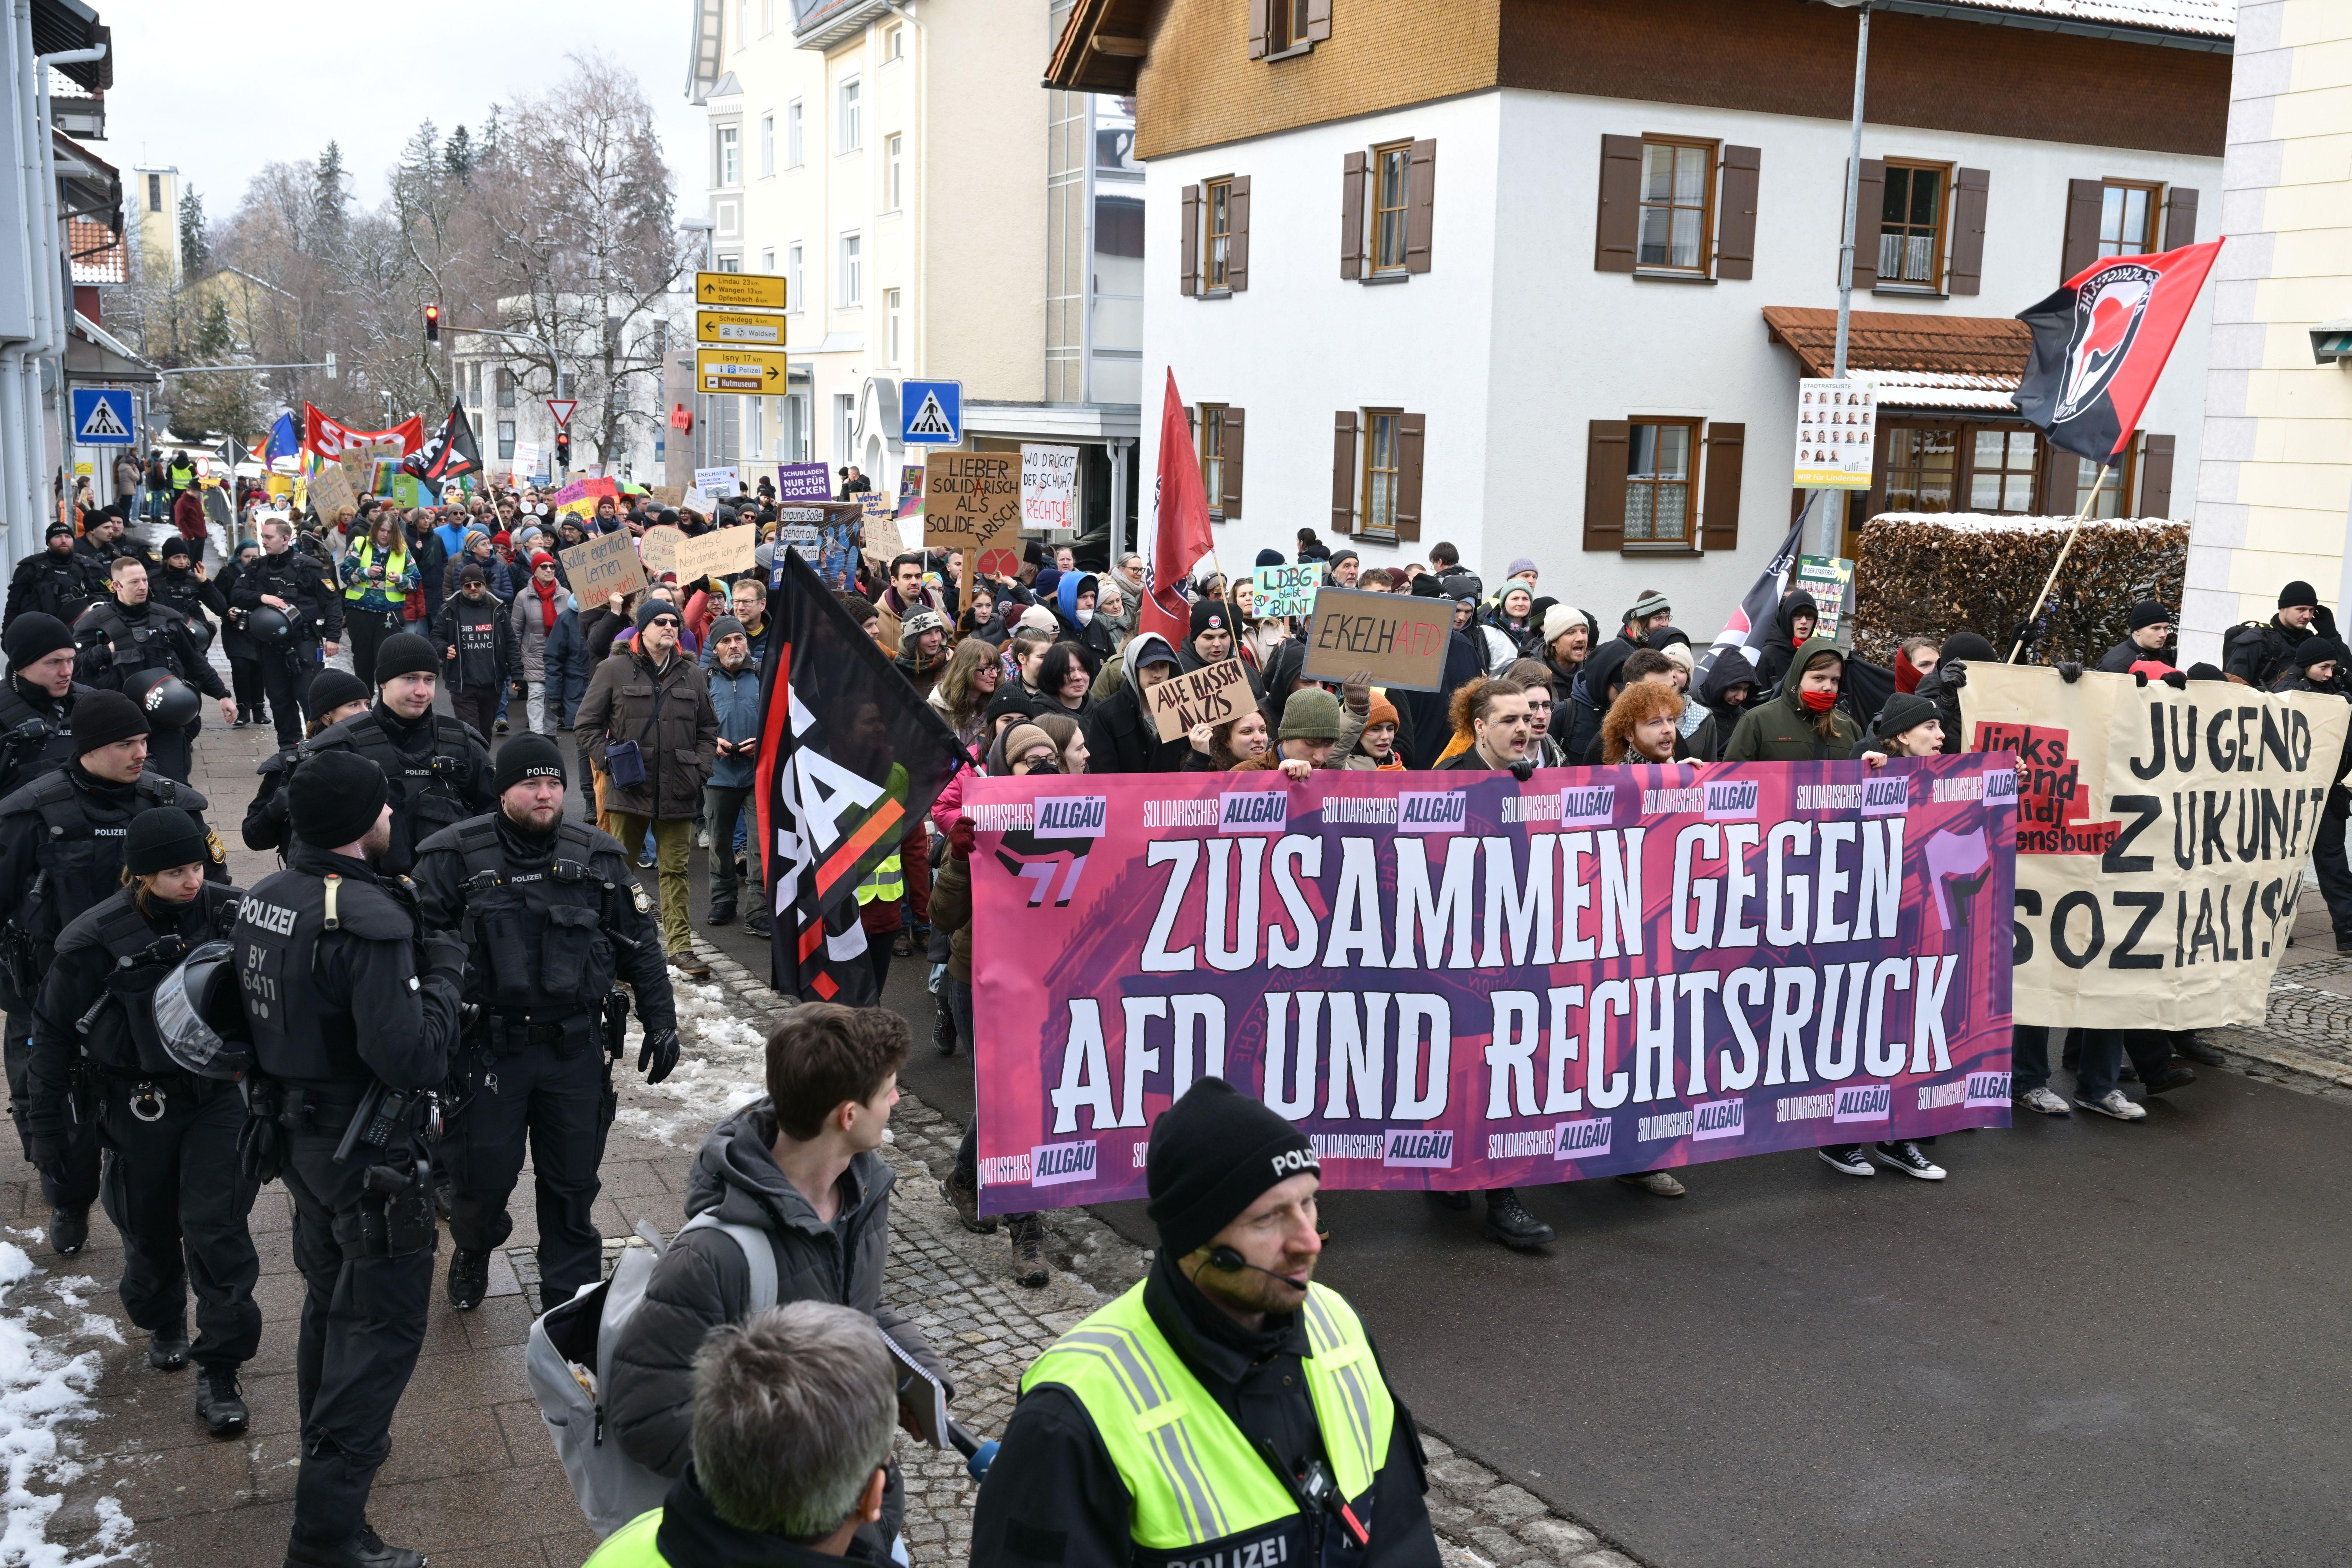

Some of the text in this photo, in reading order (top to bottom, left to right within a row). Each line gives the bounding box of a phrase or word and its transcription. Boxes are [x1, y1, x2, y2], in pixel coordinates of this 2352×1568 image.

[719, 316, 752, 324] Scheidegg
[723, 354, 739, 363] Isny
[722, 379, 757, 388] Hutmuseum
[950, 457, 1008, 480] LIEBER
[1024, 452, 1075, 469] WO DRÜCKT
[1844, 462, 1859, 472] ulli
[394, 476, 411, 485] EINE
[783, 469, 824, 477] SCHUBLADEN
[784, 475, 825, 487] NUR FÜR
[1024, 473, 1071, 493] DER SCHUH?
[1826, 475, 1868, 483] Lindenberg
[786, 486, 826, 496] SOCKEN
[932, 478, 1018, 498] SOLIDARISCH
[783, 509, 822, 521] braune Soße
[864, 508, 890, 518] fängen
[956, 495, 989, 513] ALS
[1026, 499, 1067, 527] RECHTS!
[784, 527, 817, 540] gehört auf
[865, 515, 880, 529] DAS
[883, 521, 887, 531] B
[867, 529, 879, 539] AFD
[926, 514, 975, 534] SOLIDE
[975, 500, 1019, 546] ARISCH
[653, 529, 679, 543] HALLO
[562, 533, 630, 570] Sollte eigentlich
[679, 556, 695, 568] Nein
[722, 547, 732, 557] ich
[735, 543, 748, 558] geh
[802, 547, 817, 558] nicht
[614, 573, 639, 594] auch!
[1264, 567, 1312, 590] LDBG
[1279, 587, 1302, 599] bleibt
[1268, 598, 1312, 617] BUNT
[1318, 613, 1441, 658] EKELHAFD
[1158, 660, 1243, 713] ALLE HASSEN
[1177, 690, 1232, 733] NAZIS
[2130, 702, 2311, 781] JUGEND
[527, 767, 560, 777] POLIZEI
[1642, 781, 1757, 815] SOLIDARISCHES ALLGÄU
[1797, 776, 1908, 810] SOLIDARISCHES ALLGÄU
[1933, 777, 1983, 803] SOLIDARISCHES
[1039, 796, 1105, 828] ALLGÄU
[1143, 791, 1287, 828] SOLIDARISCHES ALLGÄU
[1322, 791, 1465, 824] SOLIDARISCHES ALLGÄU
[1501, 786, 1614, 823] SOLIDARISCHES ALLGÄU
[2102, 787, 2325, 873] ZUKUNFT
[511, 873, 542, 883] POLIZEI
[1140, 817, 1906, 972] ZUSAMMEN GEGEN
[238, 896, 298, 936] POLIZEI
[248, 944, 267, 972] BY
[243, 968, 276, 1001] 6411
[1050, 993, 1226, 1135] AFD
[1263, 991, 1452, 1121] UND
[1484, 953, 1959, 1120] RECHTSRUCK
[1777, 1083, 1890, 1123] SOLIDARISCHES ALLGÄU
[1918, 1080, 1965, 1110] SOLIDARISCHES
[1638, 1098, 1744, 1143] SOLIDARISCHES ALLGÄU
[1310, 1131, 1453, 1159] SOLIDARISCHES ALLGÄU
[1488, 1117, 1612, 1159] SOLIDARISCHES ALLGÄU
[1036, 1141, 1096, 1177] ALLGÄU
